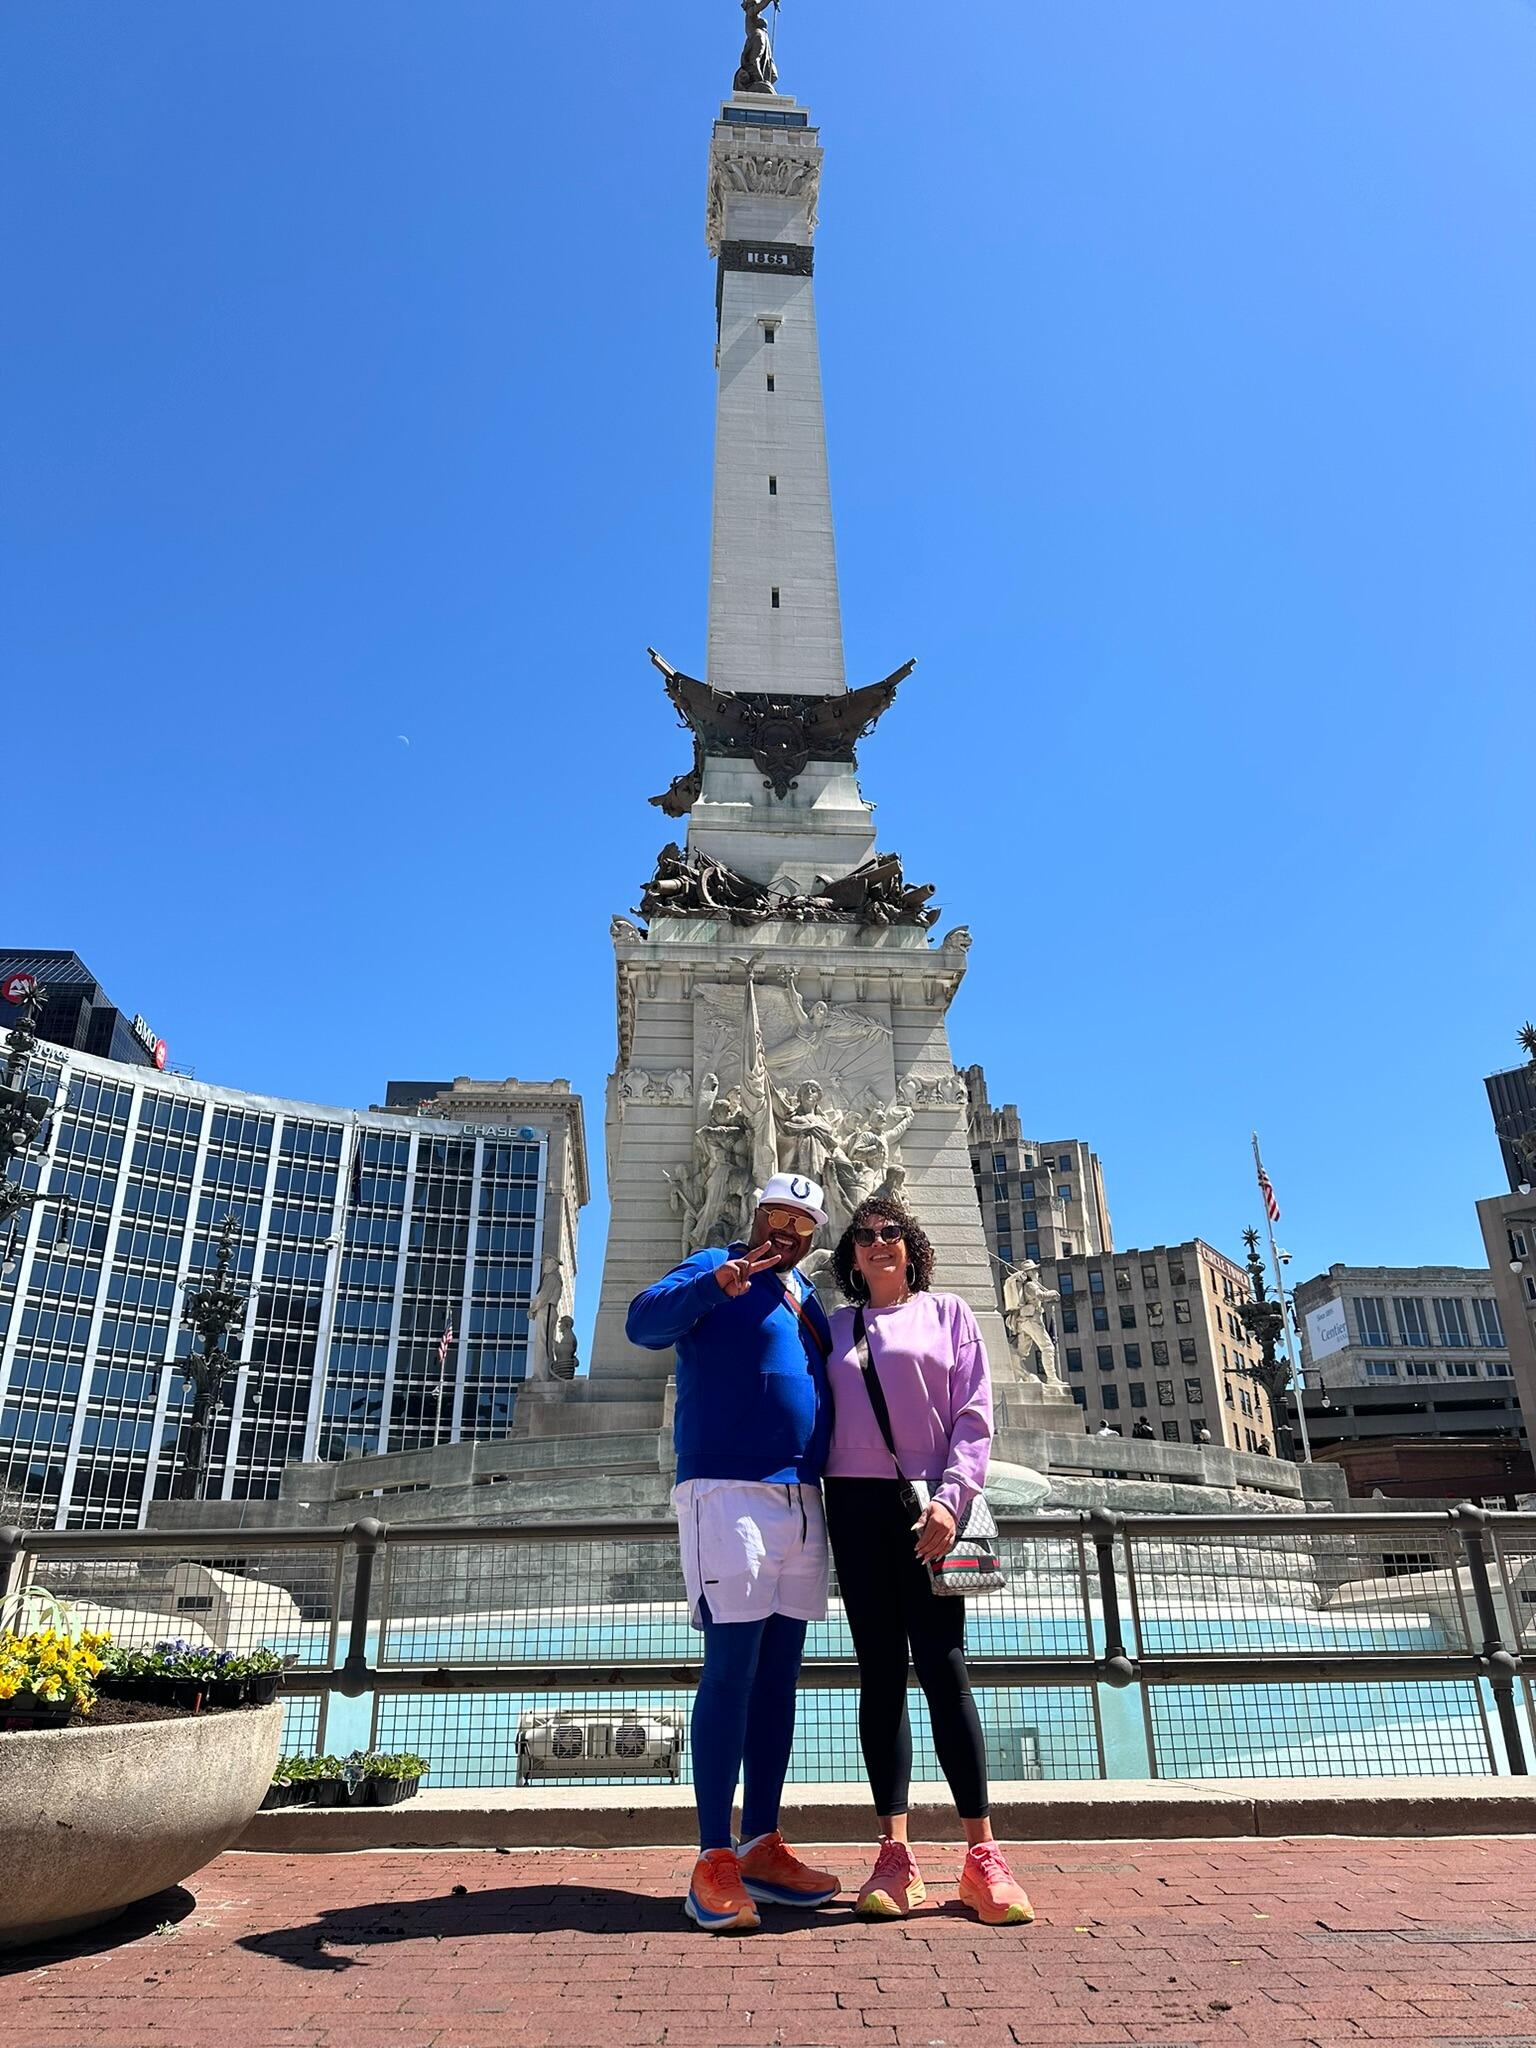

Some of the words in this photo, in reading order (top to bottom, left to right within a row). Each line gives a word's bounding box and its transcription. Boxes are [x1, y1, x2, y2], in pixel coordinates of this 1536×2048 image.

[750, 252, 786, 265] 1865
[135, 1014, 157, 1053] BMO
[463, 1124, 518, 1138] CHASE
[1321, 1322, 1347, 1342] Centier
